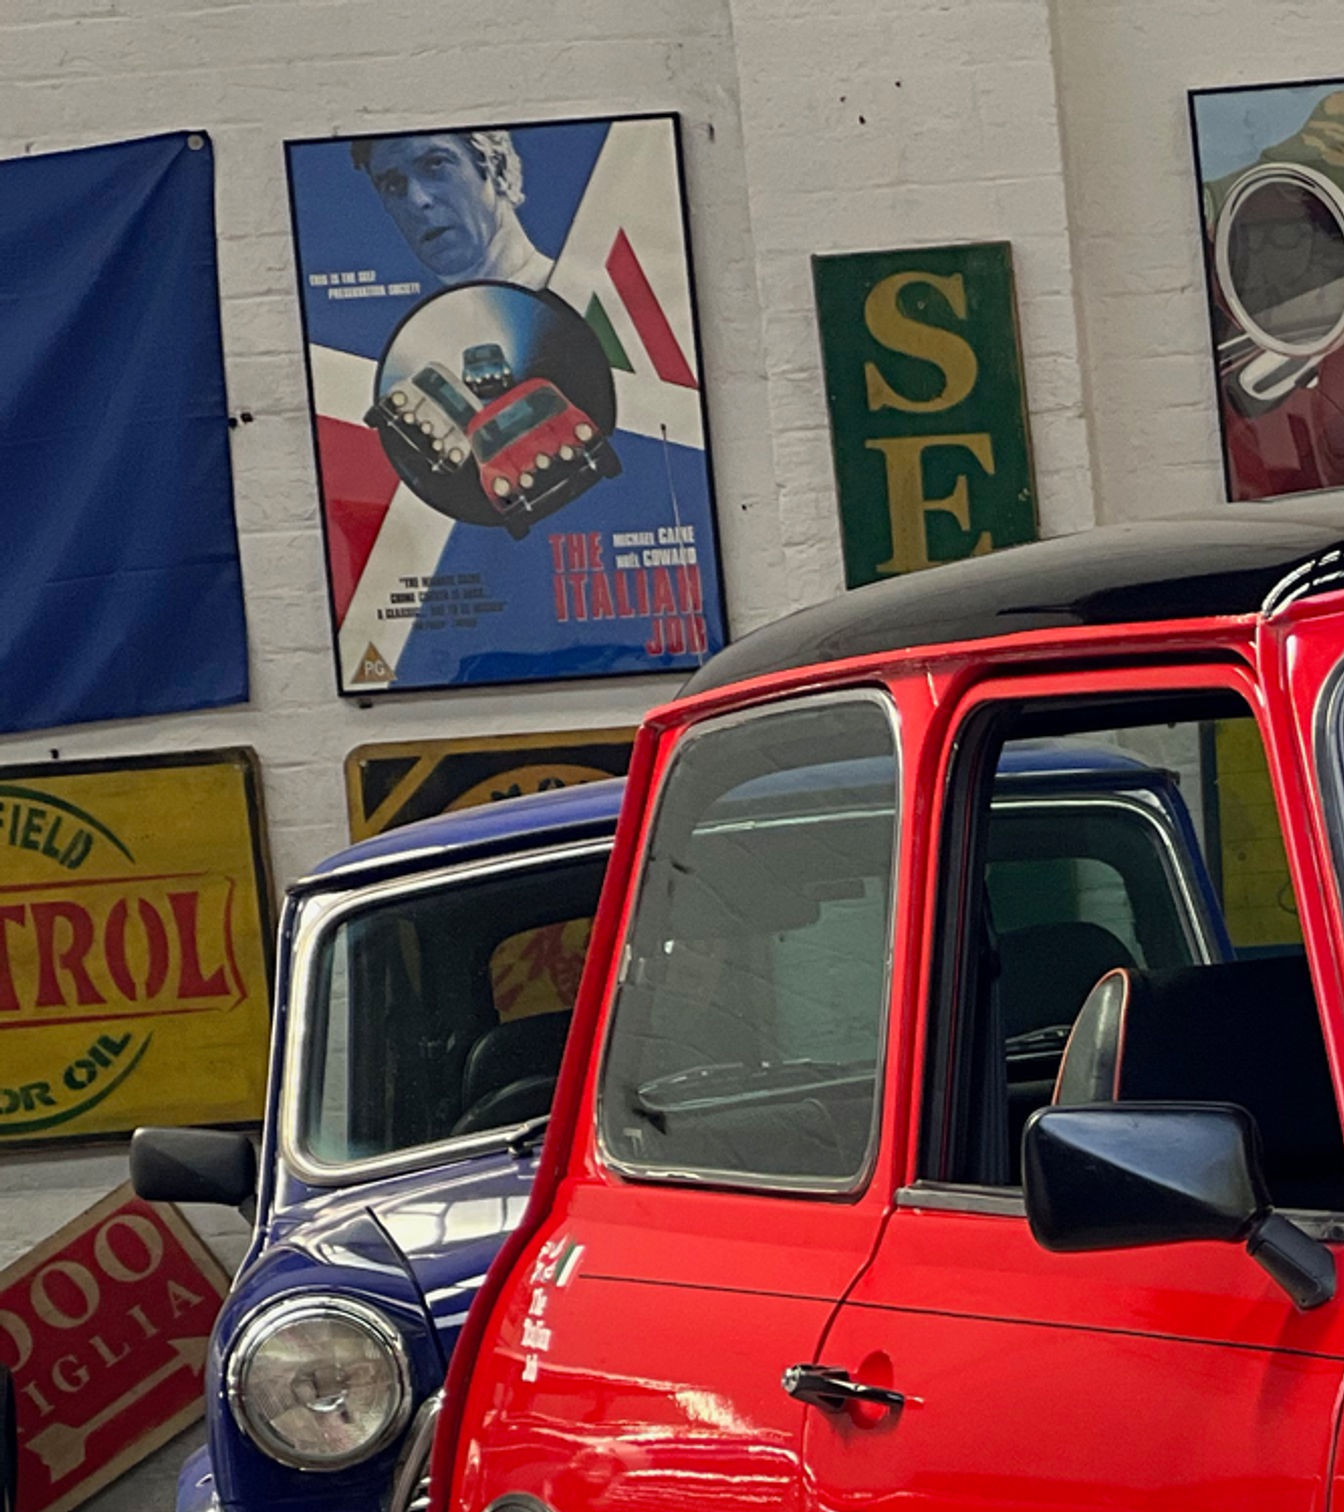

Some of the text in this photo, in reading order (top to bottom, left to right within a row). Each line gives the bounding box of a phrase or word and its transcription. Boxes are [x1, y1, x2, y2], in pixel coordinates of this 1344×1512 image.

[548, 531, 605, 574] THE
[553, 563, 703, 623] ITALIAN
[645, 614, 708, 656] JOB
[364, 660, 386, 678] PG
[0, 802, 94, 870] IELD
[63, 1031, 133, 1091] OIL
[17, 1280, 205, 1433] IGLIA
